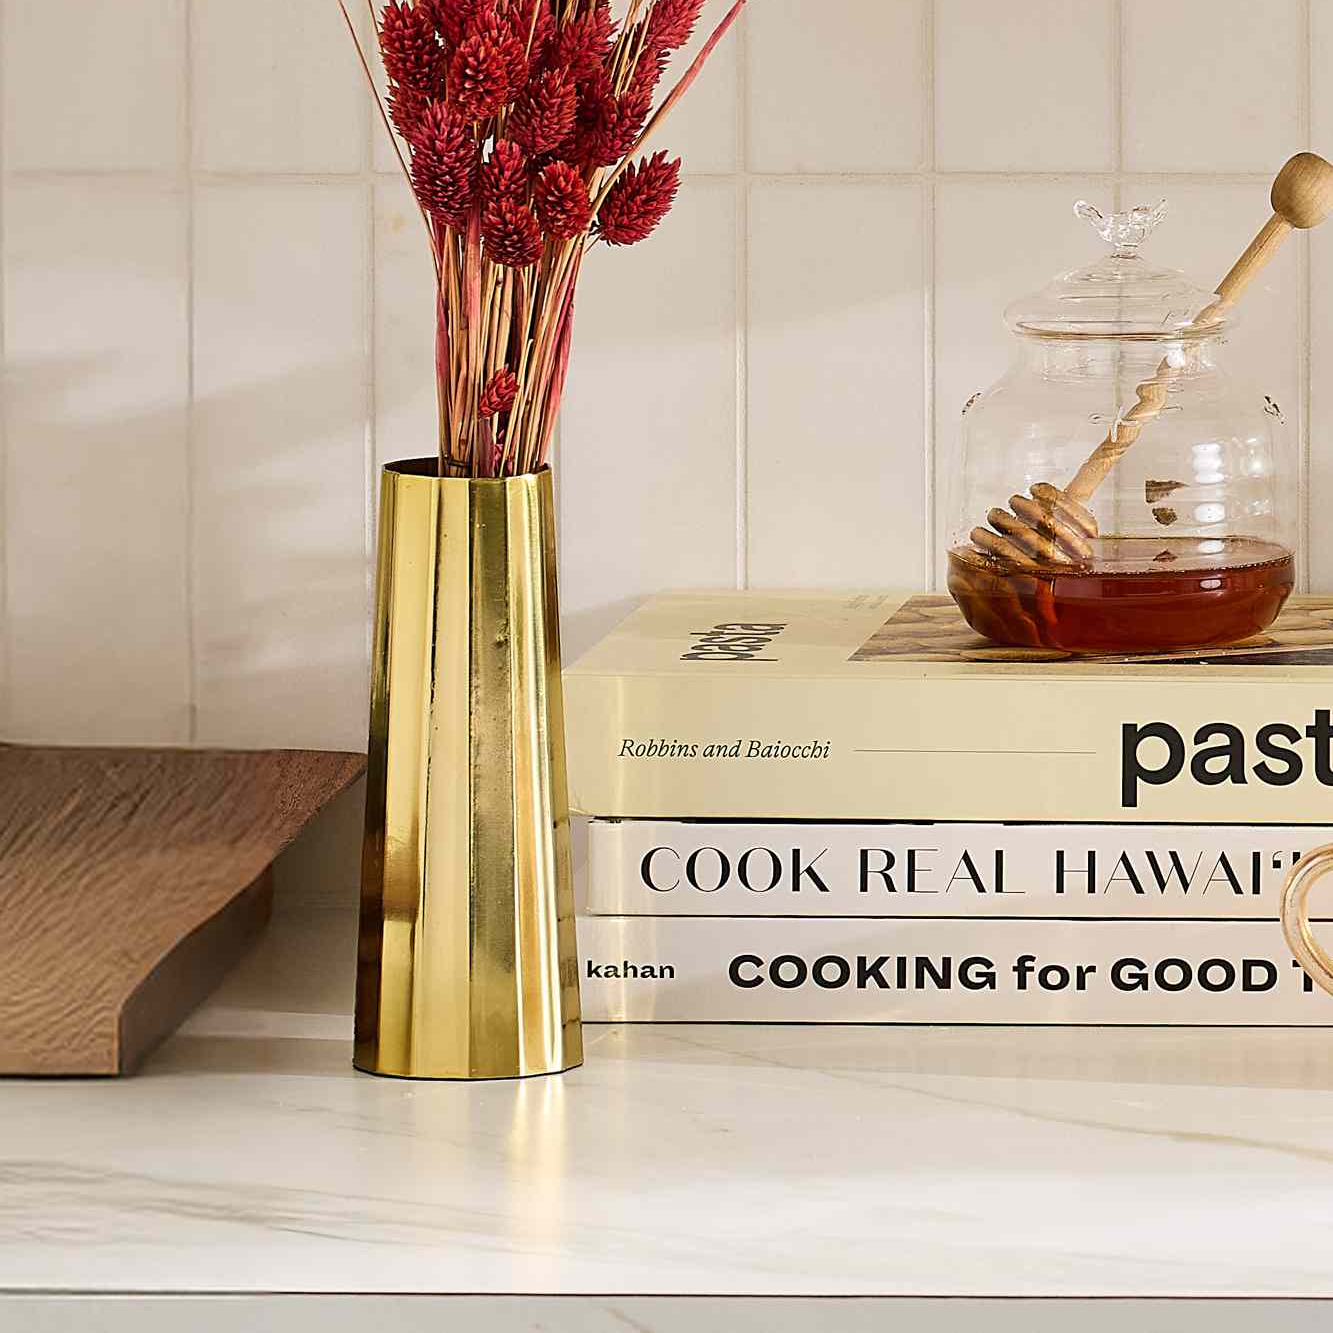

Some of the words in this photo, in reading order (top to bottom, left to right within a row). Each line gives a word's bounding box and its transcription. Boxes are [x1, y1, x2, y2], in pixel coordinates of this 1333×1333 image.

[680, 622, 788, 662] pasta
[617, 738, 699, 758] Robbins
[702, 739, 742, 758] and
[744, 739, 832, 759] Baiocchi
[640, 846, 831, 893] COOK
[859, 848, 1026, 894] REAL
[586, 959, 675, 979] kahan
[728, 954, 997, 991] COOKING
[1012, 954, 1097, 991] for
[1110, 958, 1278, 992] GOOD
